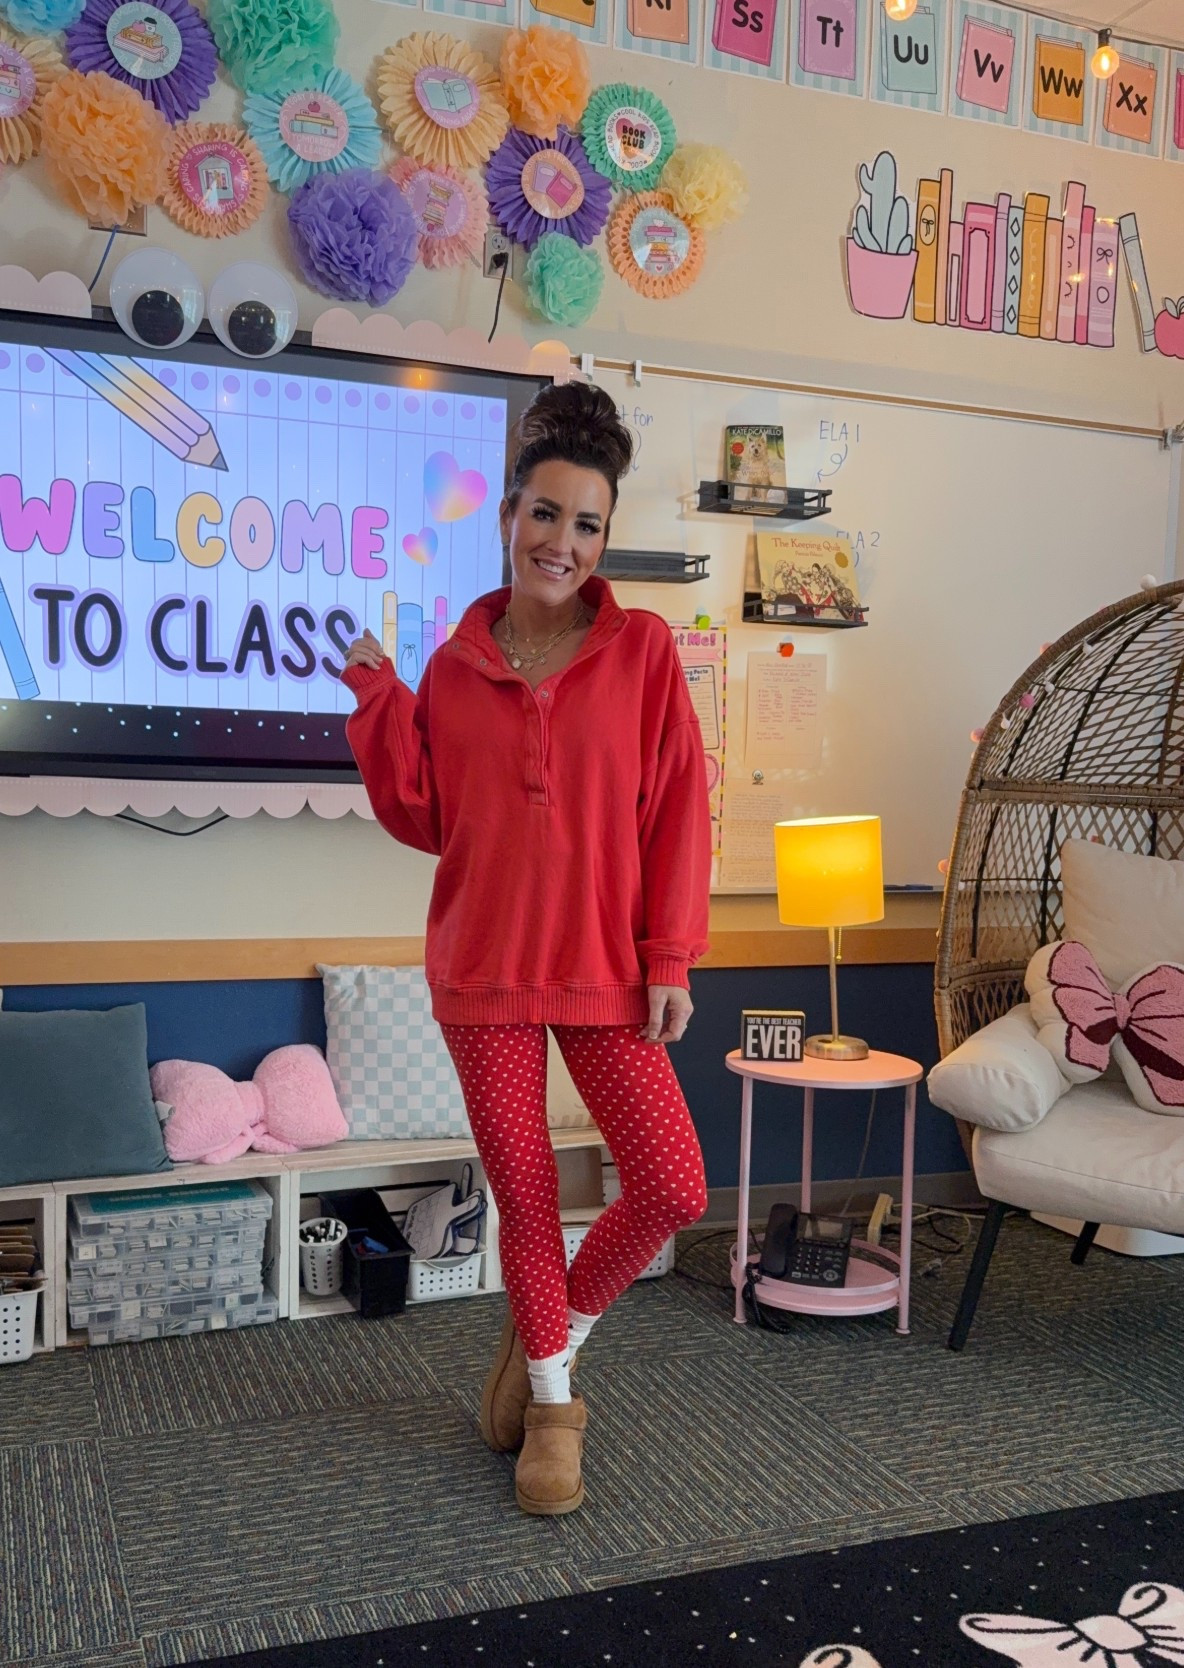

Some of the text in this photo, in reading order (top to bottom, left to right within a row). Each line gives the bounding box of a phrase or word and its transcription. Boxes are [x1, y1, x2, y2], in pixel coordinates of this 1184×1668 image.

[731, 0, 764, 33] Ss
[817, 16, 844, 48] Tt
[894, 34, 929, 65] Uu
[974, 49, 1004, 83] Vv
[1040, 65, 1083, 98] Ww
[1116, 81, 1148, 116] Xx
[621, 135, 645, 150] CLUB
[622, 125, 646, 140] BOOK
[192, 143, 228, 156] SHARING
[229, 149, 238, 158] IS
[180, 162, 194, 193] CARING
[633, 406, 654, 427] for
[732, 428, 748, 436] KATE
[820, 420, 848, 441] ELA
[0, 473, 390, 579] WELCOME
[771, 537, 841, 553] The Keeping Quilt
[871, 531, 881, 548] 2
[30, 584, 358, 678] TO CLASS
[687, 632, 717, 647] Me!
[747, 1016, 761, 1024] YOU'RE
[783, 1018, 801, 1026] TEACHER
[746, 1025, 801, 1059] EVER
